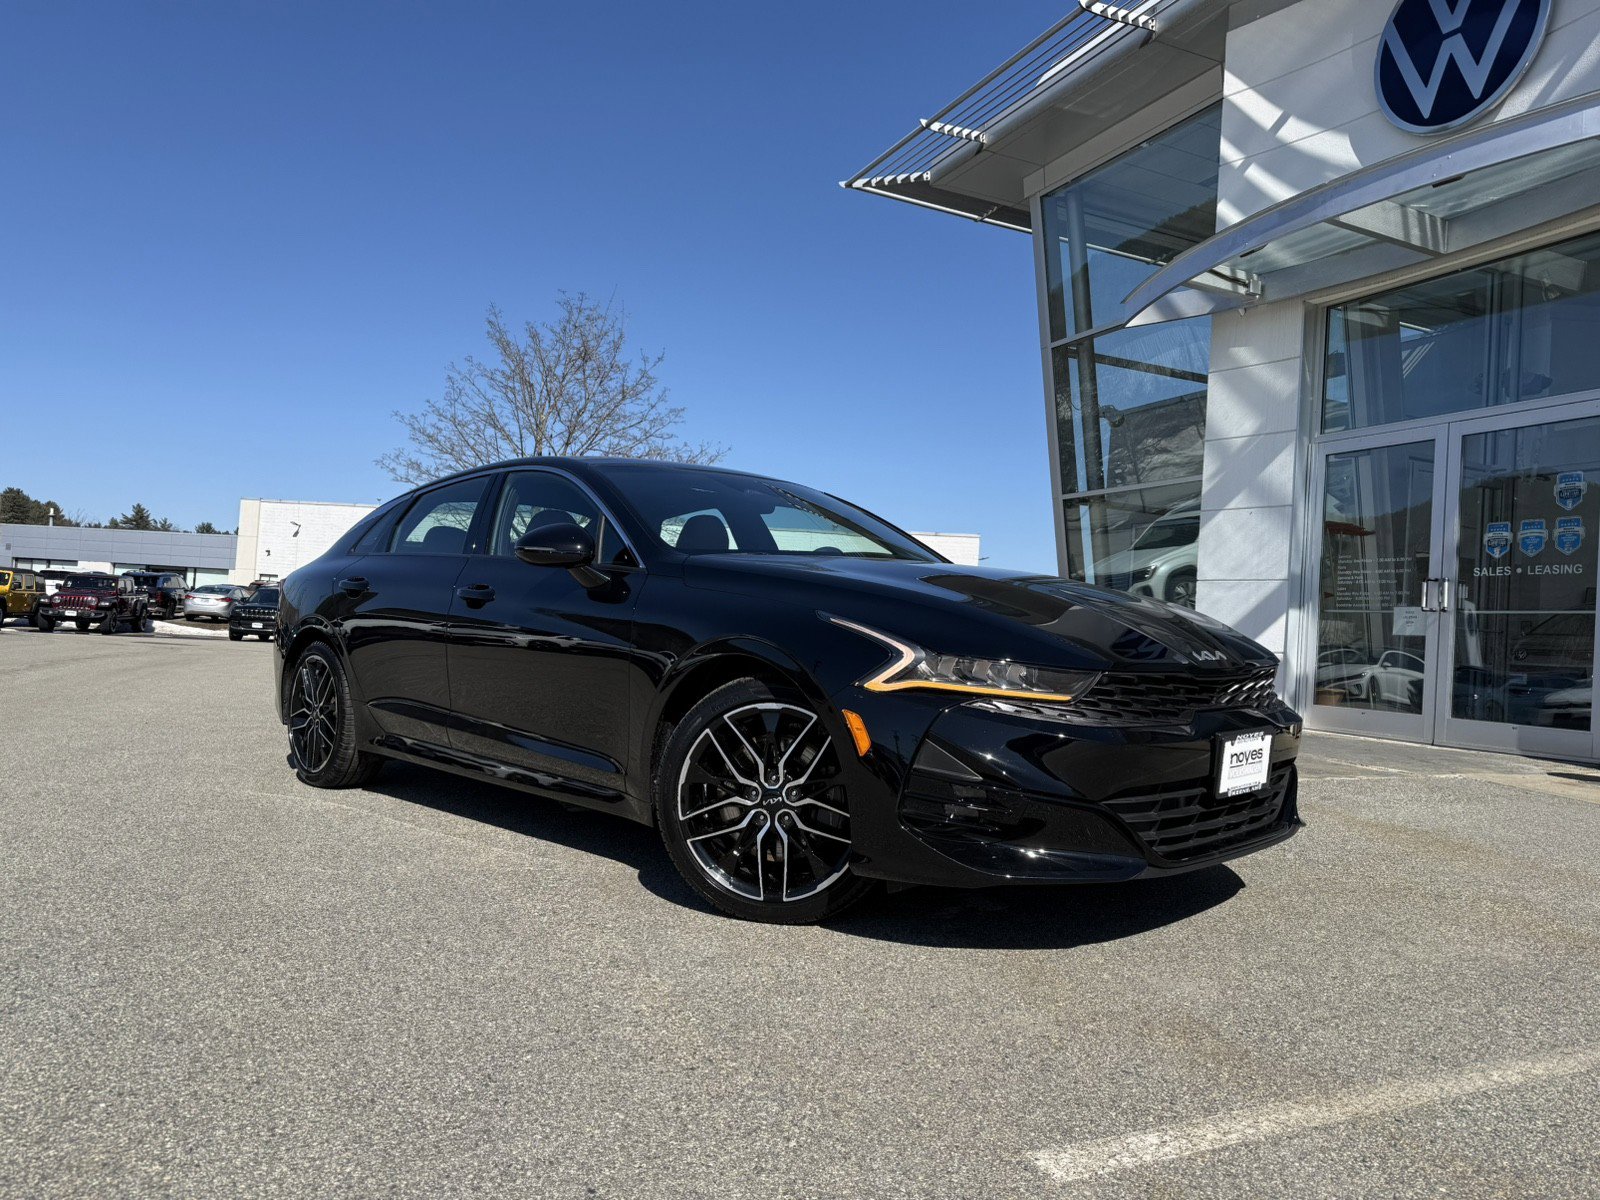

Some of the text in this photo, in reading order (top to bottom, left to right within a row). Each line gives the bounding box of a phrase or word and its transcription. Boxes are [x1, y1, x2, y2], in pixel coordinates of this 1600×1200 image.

[1473, 563, 1583, 577] SALES LEASING
[1192, 650, 1227, 661] KIA
[1230, 748, 1263, 765] noyes
